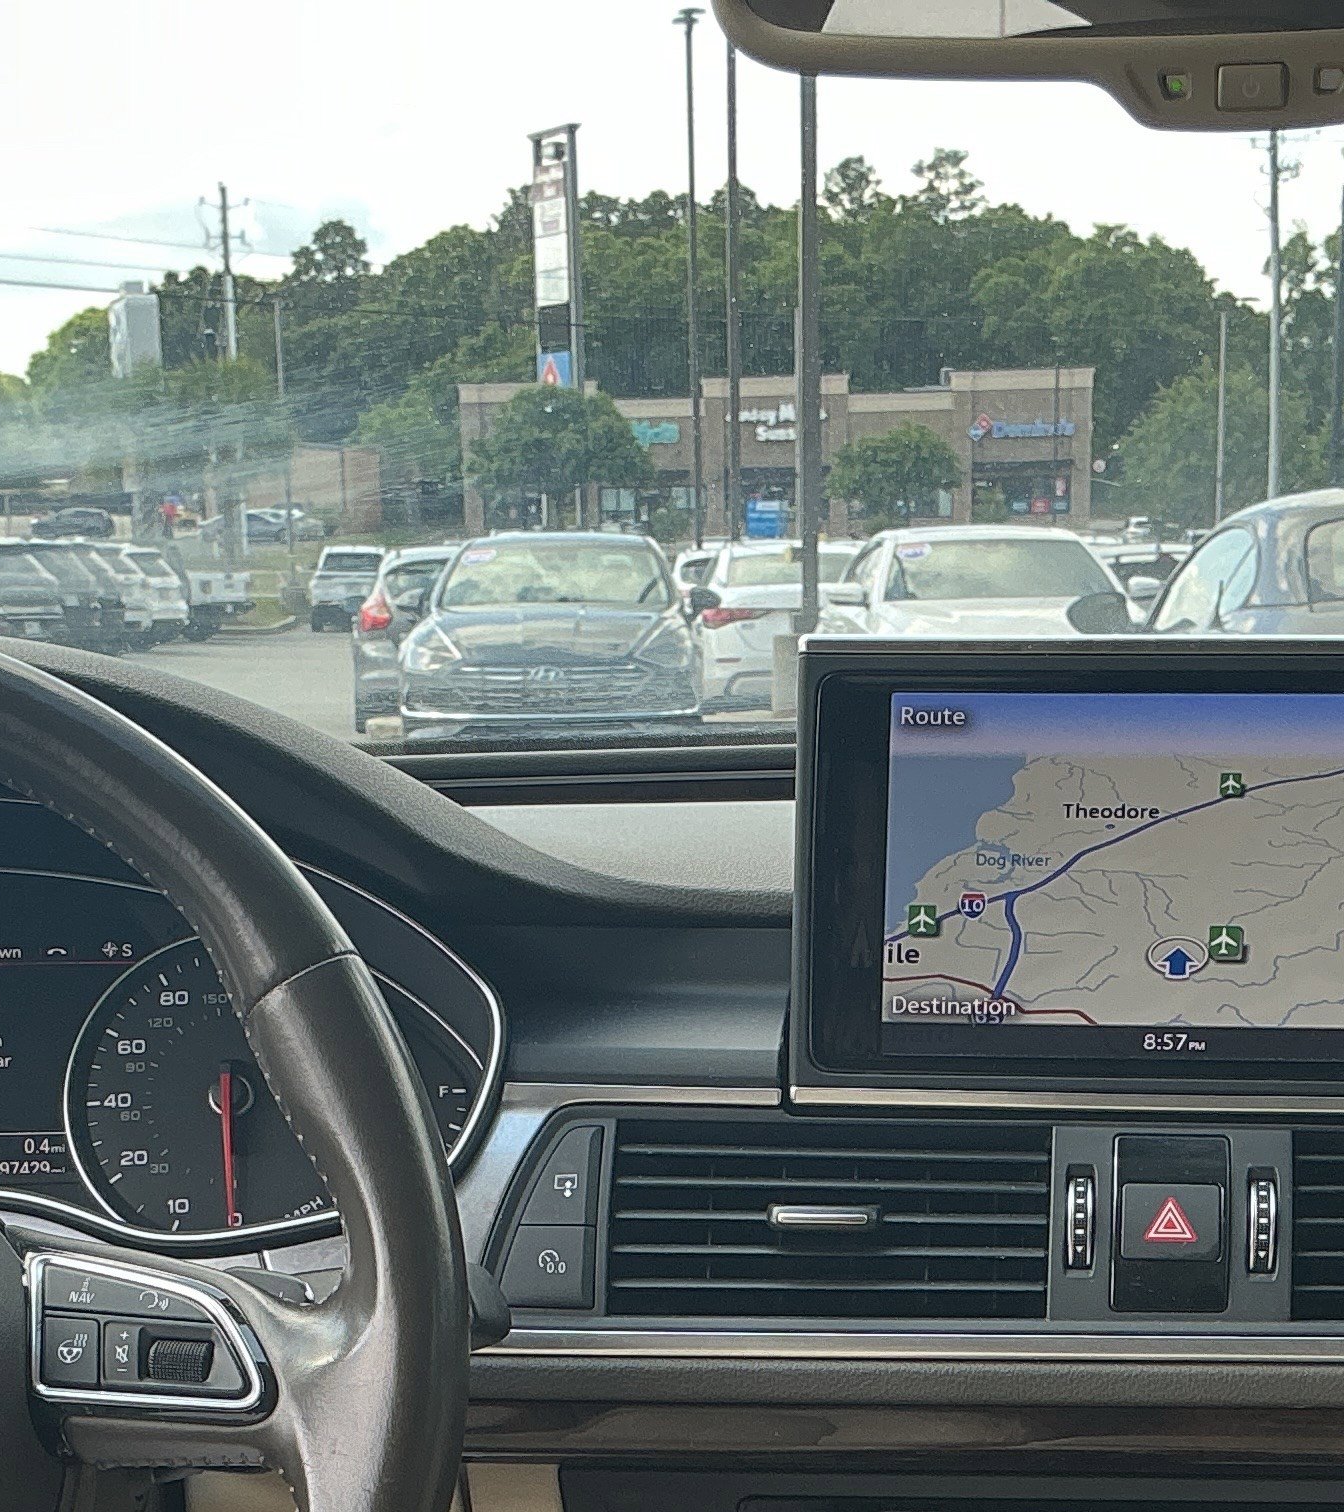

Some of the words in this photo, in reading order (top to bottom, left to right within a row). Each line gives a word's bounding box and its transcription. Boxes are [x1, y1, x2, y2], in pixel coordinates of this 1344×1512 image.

[900, 706, 966, 725] Route
[1062, 803, 1160, 819] Theodore
[976, 853, 1006, 869] Dog
[1012, 854, 1052, 867] River
[962, 900, 984, 912] 10
[122, 944, 132, 957] S
[887, 943, 920, 964] ile
[159, 991, 189, 1006] 80
[202, 993, 227, 1004] 150
[892, 996, 1016, 1015] Destination
[148, 1018, 173, 1028] 120
[117, 1039, 146, 1054] 60
[439, 1085, 449, 1098] F
[103, 1093, 131, 1108] 40
[120, 1111, 141, 1121] 60
[120, 1150, 148, 1165] 20
[150, 1163, 169, 1174] 30
[167, 1198, 190, 1214] 10
[546, 1262, 566, 1273] 0.0
[68, 1292, 96, 1304] NAV
